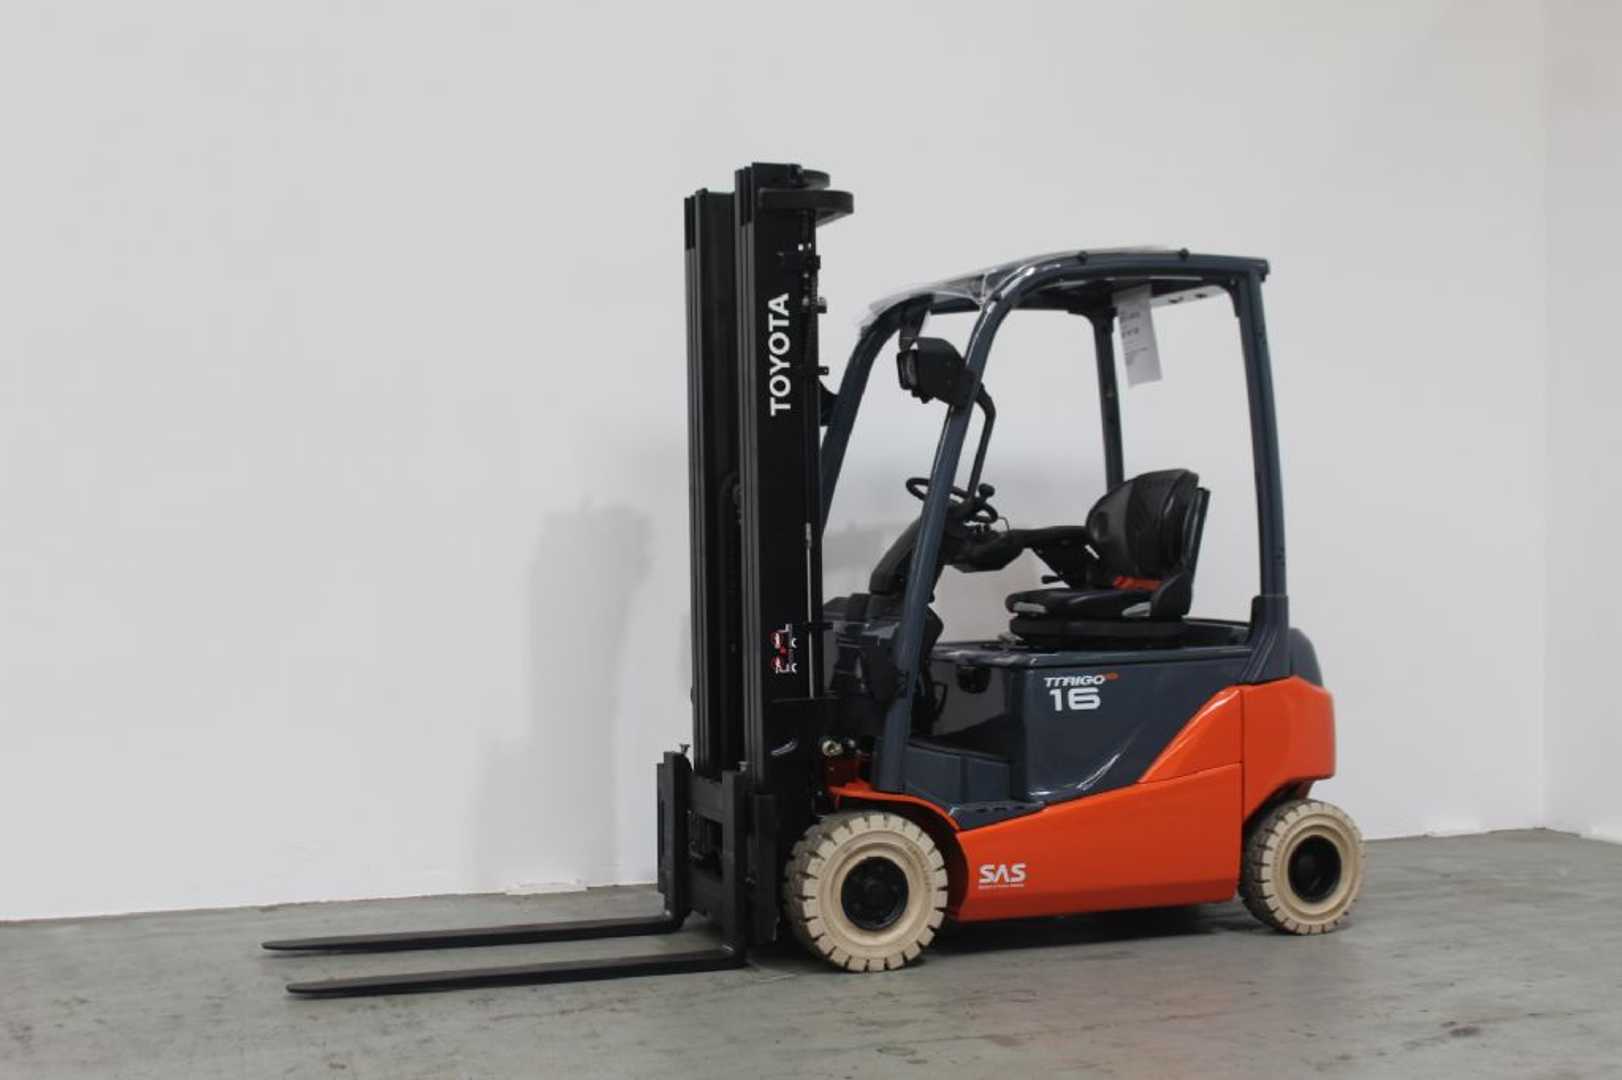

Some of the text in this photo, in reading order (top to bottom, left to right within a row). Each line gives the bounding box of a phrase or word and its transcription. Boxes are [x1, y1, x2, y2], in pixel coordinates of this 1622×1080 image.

[768, 293, 791, 416] TOYOTA
[1049, 687, 1101, 712] 16
[979, 863, 1026, 883] SAS
